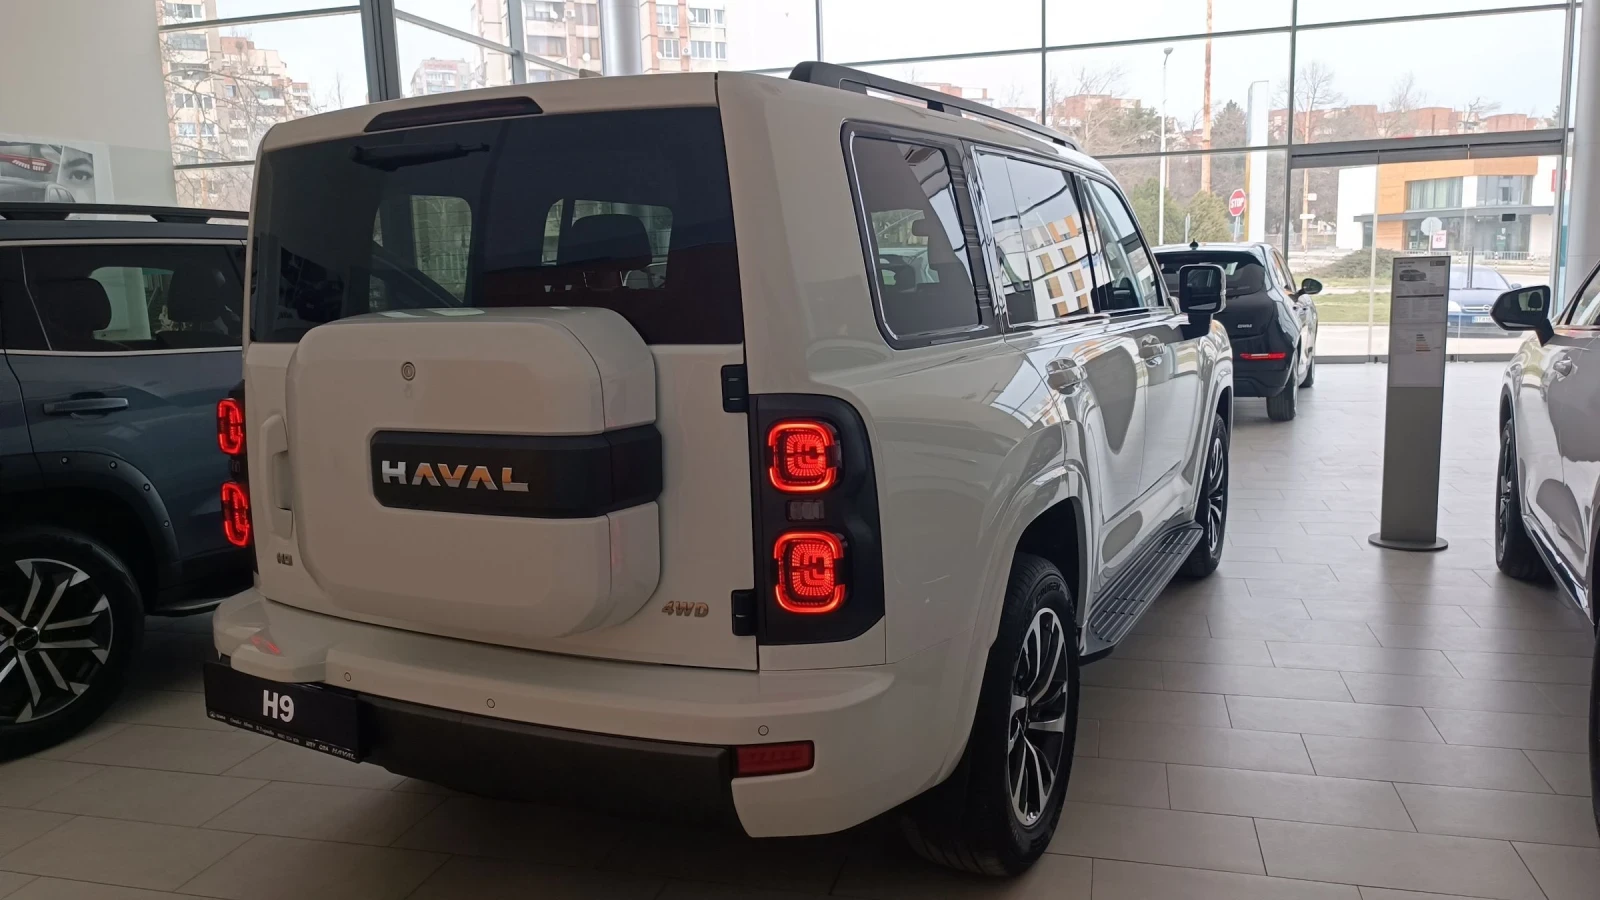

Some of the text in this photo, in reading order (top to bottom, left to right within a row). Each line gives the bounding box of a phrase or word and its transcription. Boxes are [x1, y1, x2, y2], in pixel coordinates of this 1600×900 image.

[1230, 197, 1244, 208] STOP
[381, 460, 530, 492] HAVAL
[661, 600, 709, 618] 4WD
[262, 689, 295, 723] H9
[331, 747, 356, 760] HAVAL
